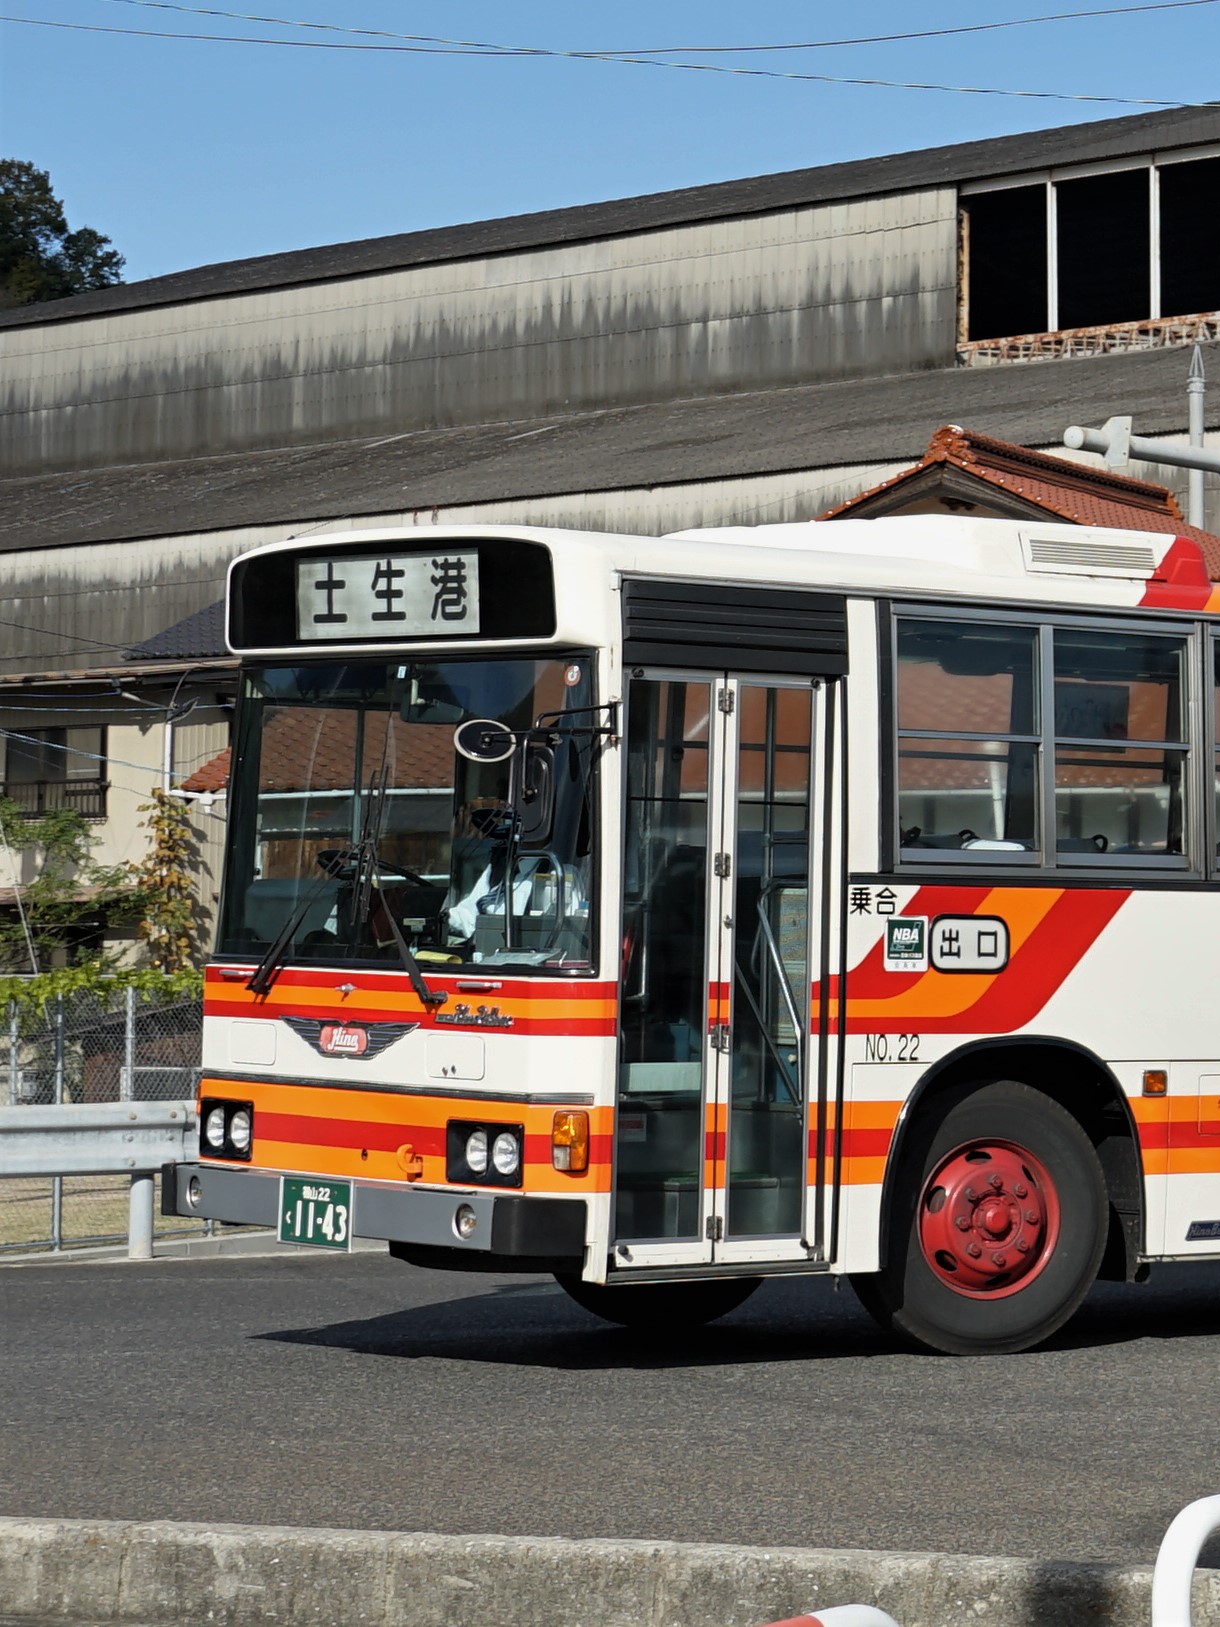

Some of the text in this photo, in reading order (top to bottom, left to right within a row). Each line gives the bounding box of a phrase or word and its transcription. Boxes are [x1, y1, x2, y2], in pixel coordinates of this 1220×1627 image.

[313, 557, 467, 623] 土生港
[850, 887, 897, 915] 乗合
[893, 928, 919, 941] NBA
[940, 928, 997, 958] 出口
[327, 1027, 359, 1052] Hino
